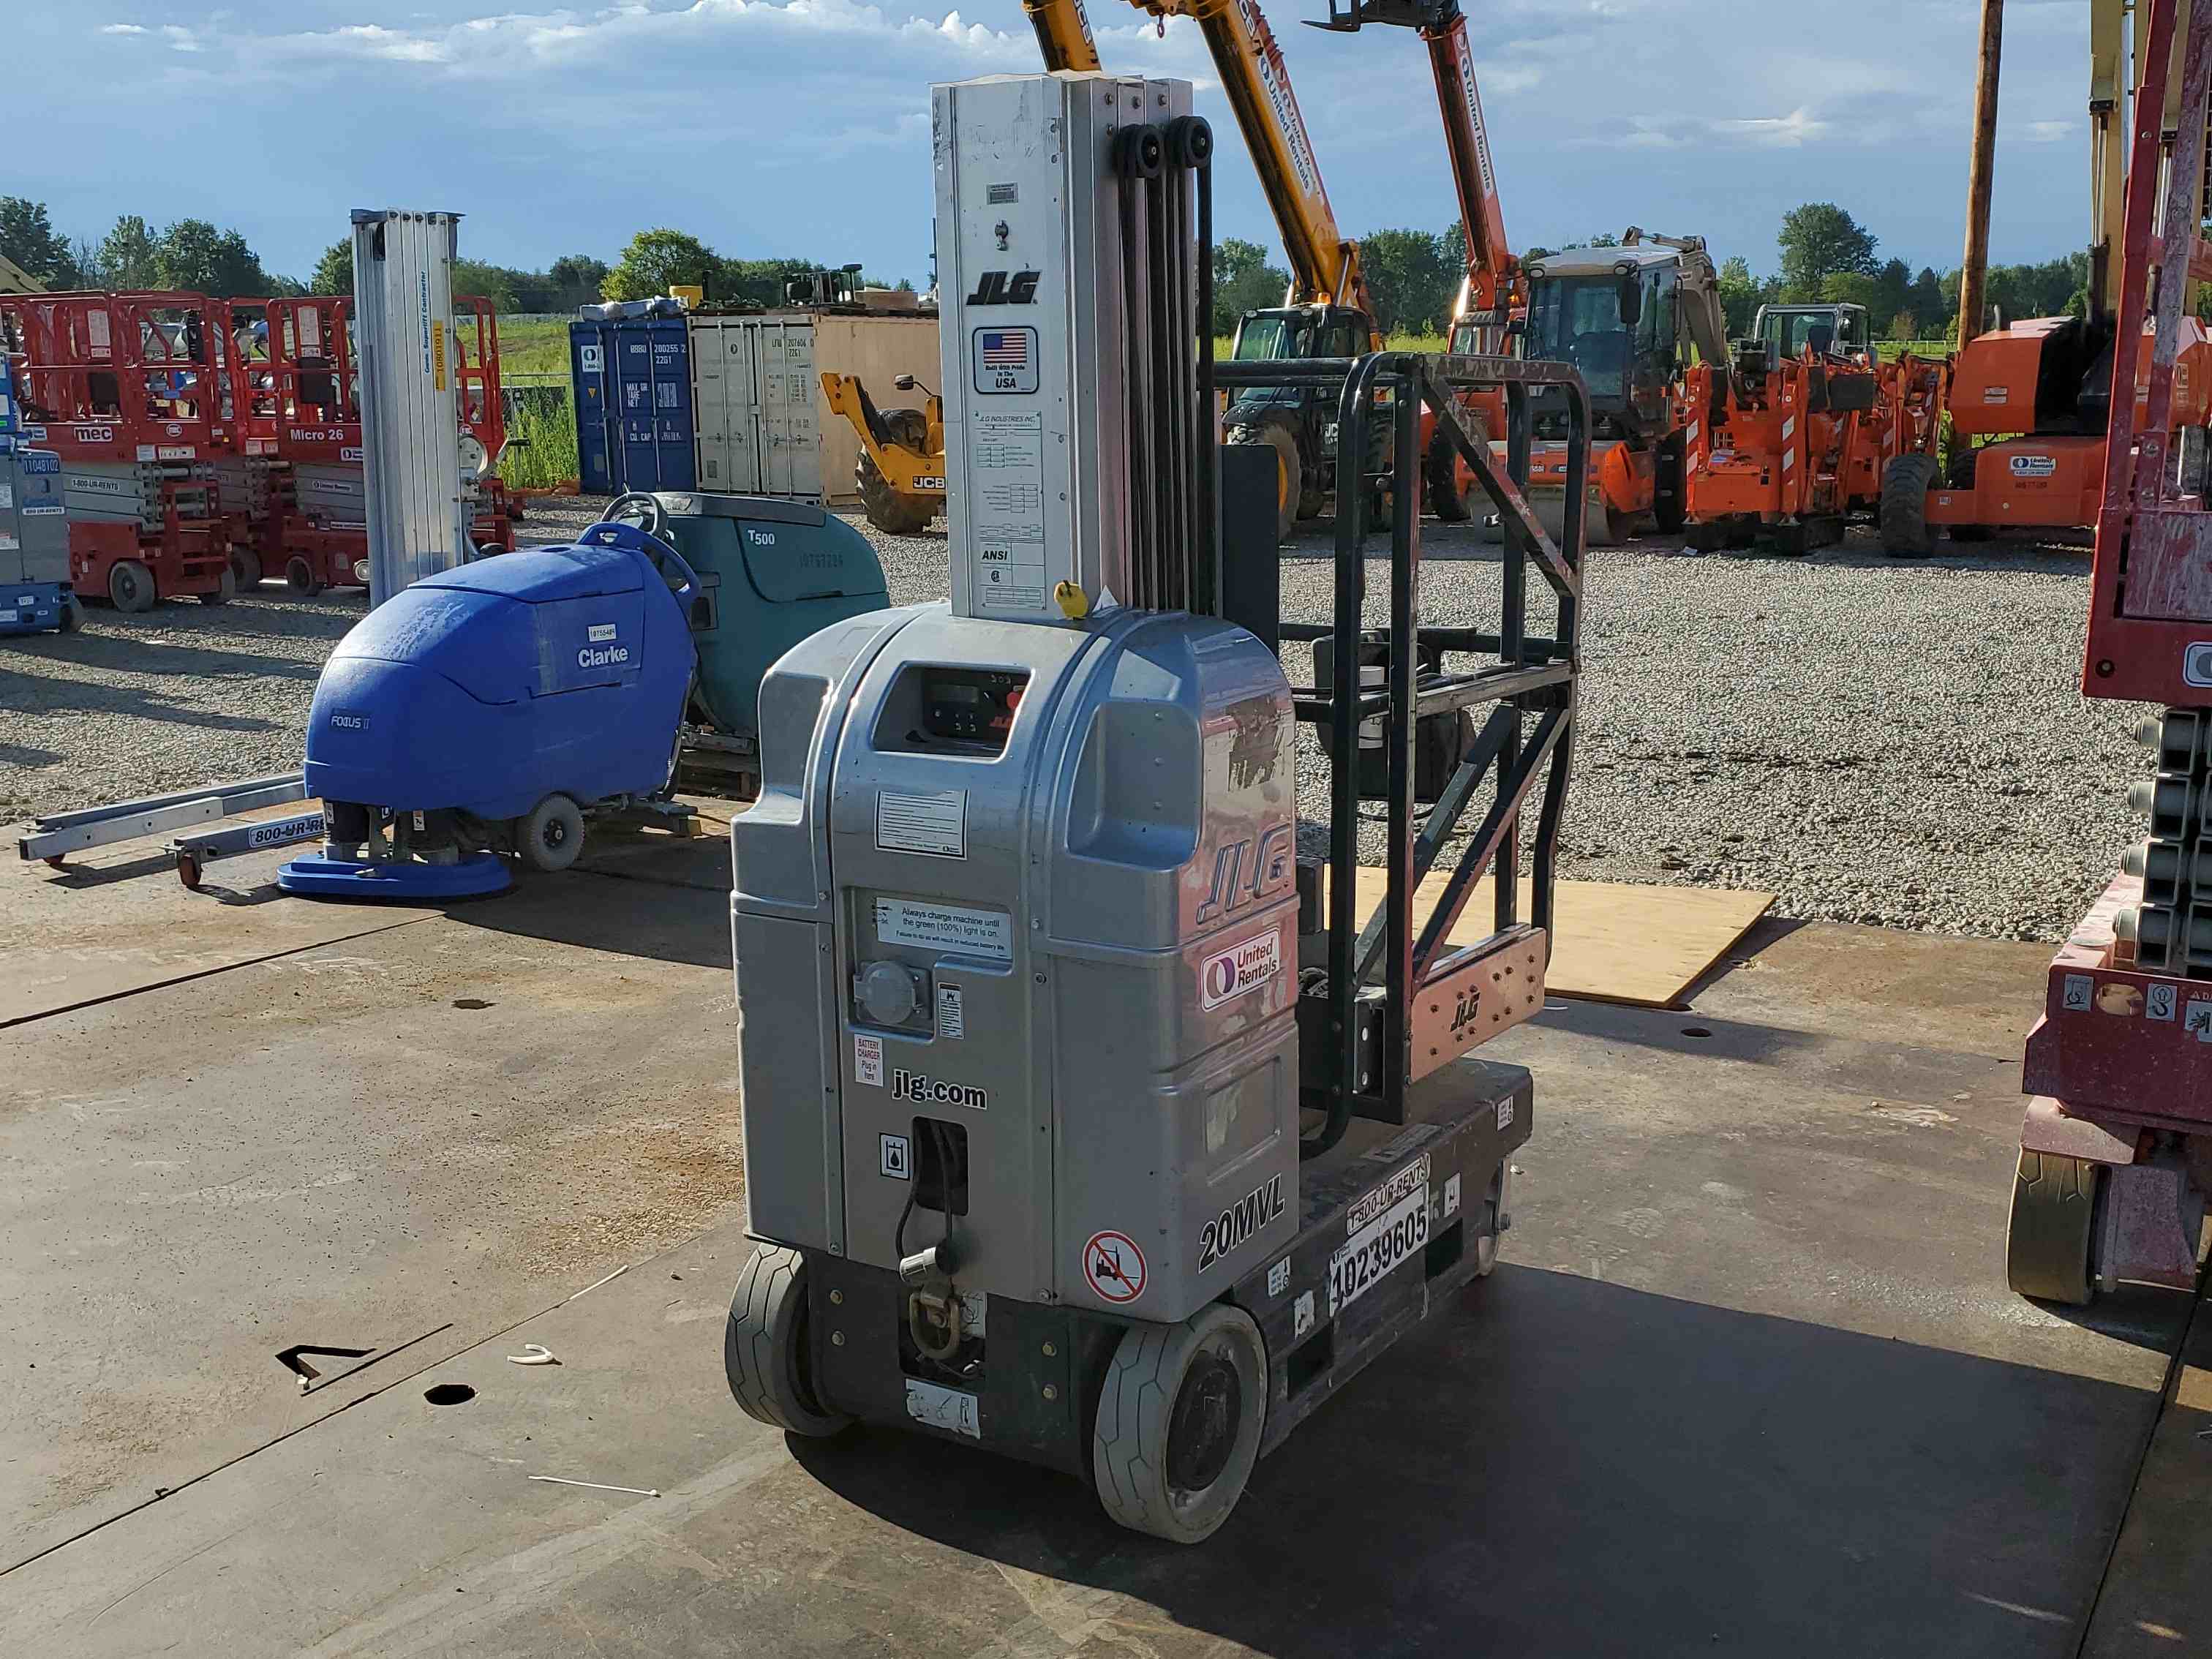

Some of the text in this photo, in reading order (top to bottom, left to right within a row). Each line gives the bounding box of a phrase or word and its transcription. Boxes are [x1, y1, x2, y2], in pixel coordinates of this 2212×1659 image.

[1268, 80, 1310, 190] United Rentals
[1465, 81, 1491, 190] United Rentals
[966, 271, 1041, 306] JLG
[995, 377, 1017, 388] USA
[76, 428, 111, 440] mec
[290, 429, 344, 440] Micro 26
[914, 477, 946, 489] JCB
[748, 530, 775, 546] T500
[982, 550, 1008, 560] ANSI
[578, 645, 628, 668] Clarke
[331, 715, 361, 729] FOCUS
[901, 907, 1000, 928] Always charge machine until
[903, 918, 914, 927] the
[915, 921, 936, 930] green
[937, 922, 962, 935] (100%)
[963, 925, 979, 936] light
[1237, 937, 1274, 968] United
[1238, 957, 1277, 988] Rentals
[858, 1038, 879, 1050] BATTERY
[857, 1048, 880, 1060] CHARGER
[892, 1069, 987, 1110] jlg.com
[1198, 1173, 1286, 1275] 20MVL
[1331, 1207, 1427, 1309] 10239605
